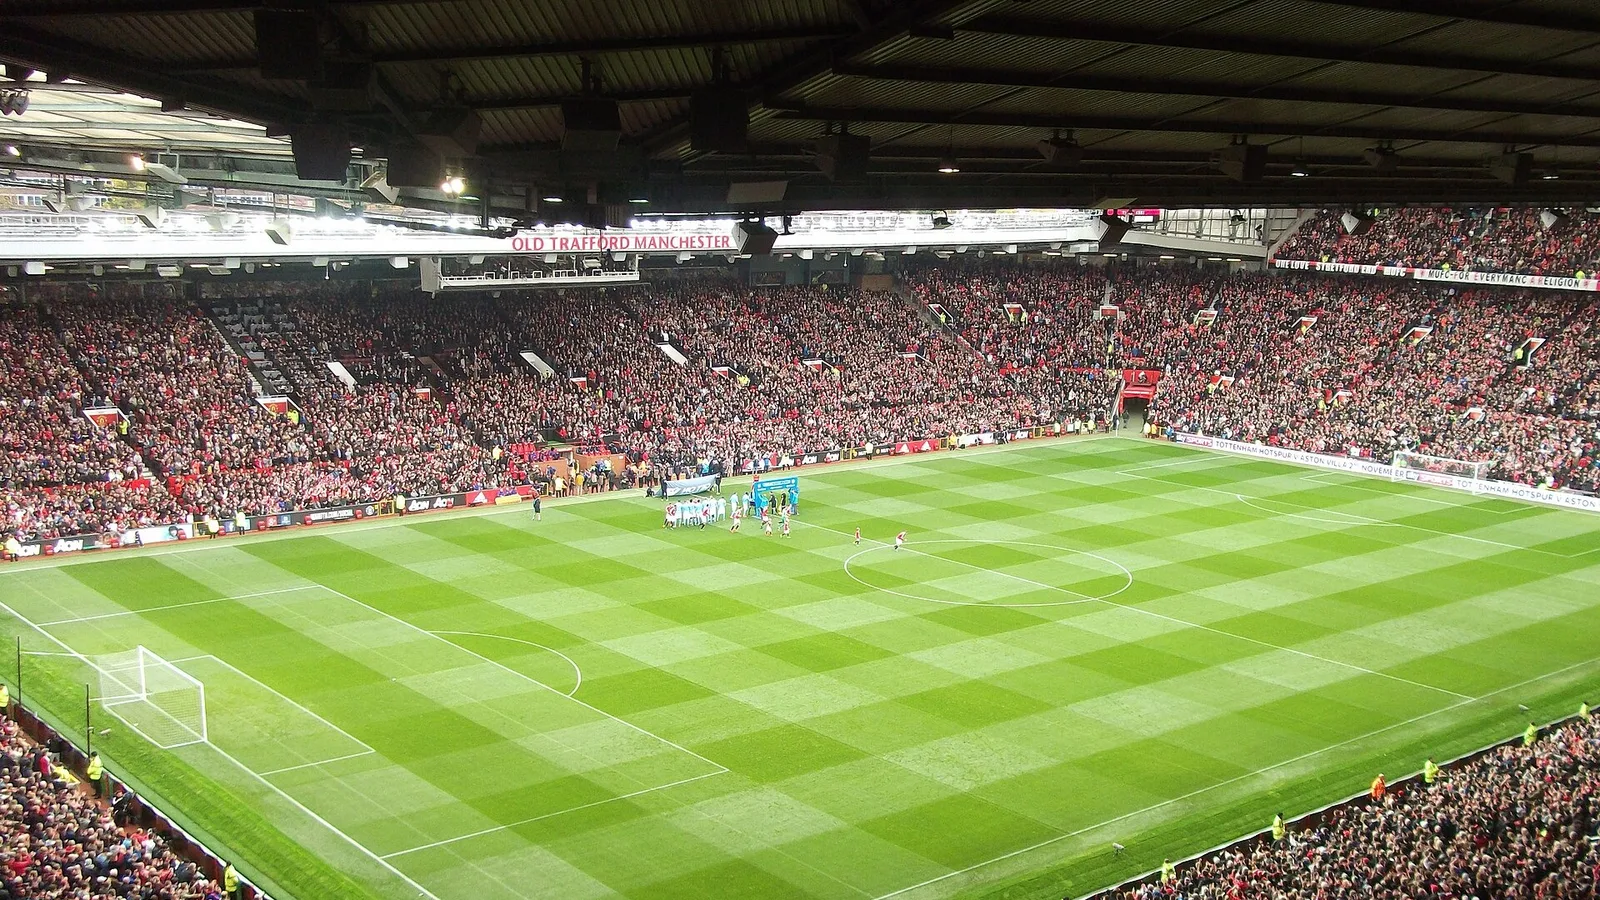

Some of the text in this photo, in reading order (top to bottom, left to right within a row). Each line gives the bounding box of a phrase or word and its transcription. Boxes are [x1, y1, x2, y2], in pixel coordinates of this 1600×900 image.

[512, 235, 730, 251] OLD TRAFFORD MANCHESTER
[1275, 260, 1309, 270] ONE LOVE
[1315, 262, 1377, 275] STRETFORD END
[1383, 266, 1407, 277] MUFC
[1537, 276, 1580, 288] RELIGION
[1215, 440, 1258, 454] TOTTENHAM
[1259, 448, 1292, 459] HOTSPUR
[1300, 454, 1325, 464] ASTON
[1512, 488, 1553, 501] HOTSPUR
[1565, 496, 1596, 508] ASTON
